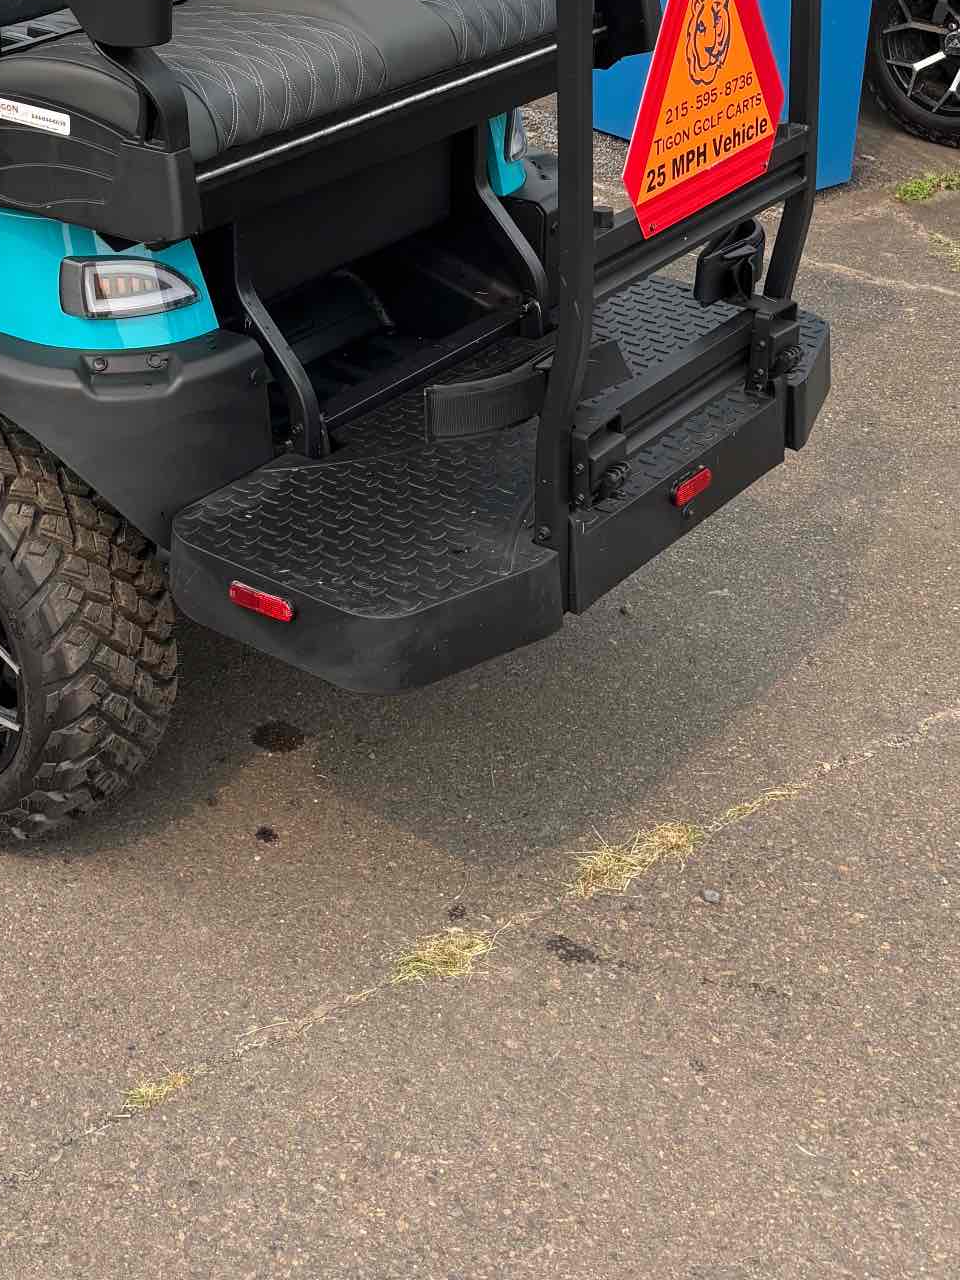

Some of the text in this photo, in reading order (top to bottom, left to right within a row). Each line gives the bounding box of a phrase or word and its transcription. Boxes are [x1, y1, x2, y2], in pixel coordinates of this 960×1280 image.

[654, 93, 762, 155] TIGON GOLF CARTS
[665, 72, 753, 125] 215-595-8736
[646, 117, 768, 193] 25 MPH Vehicle
